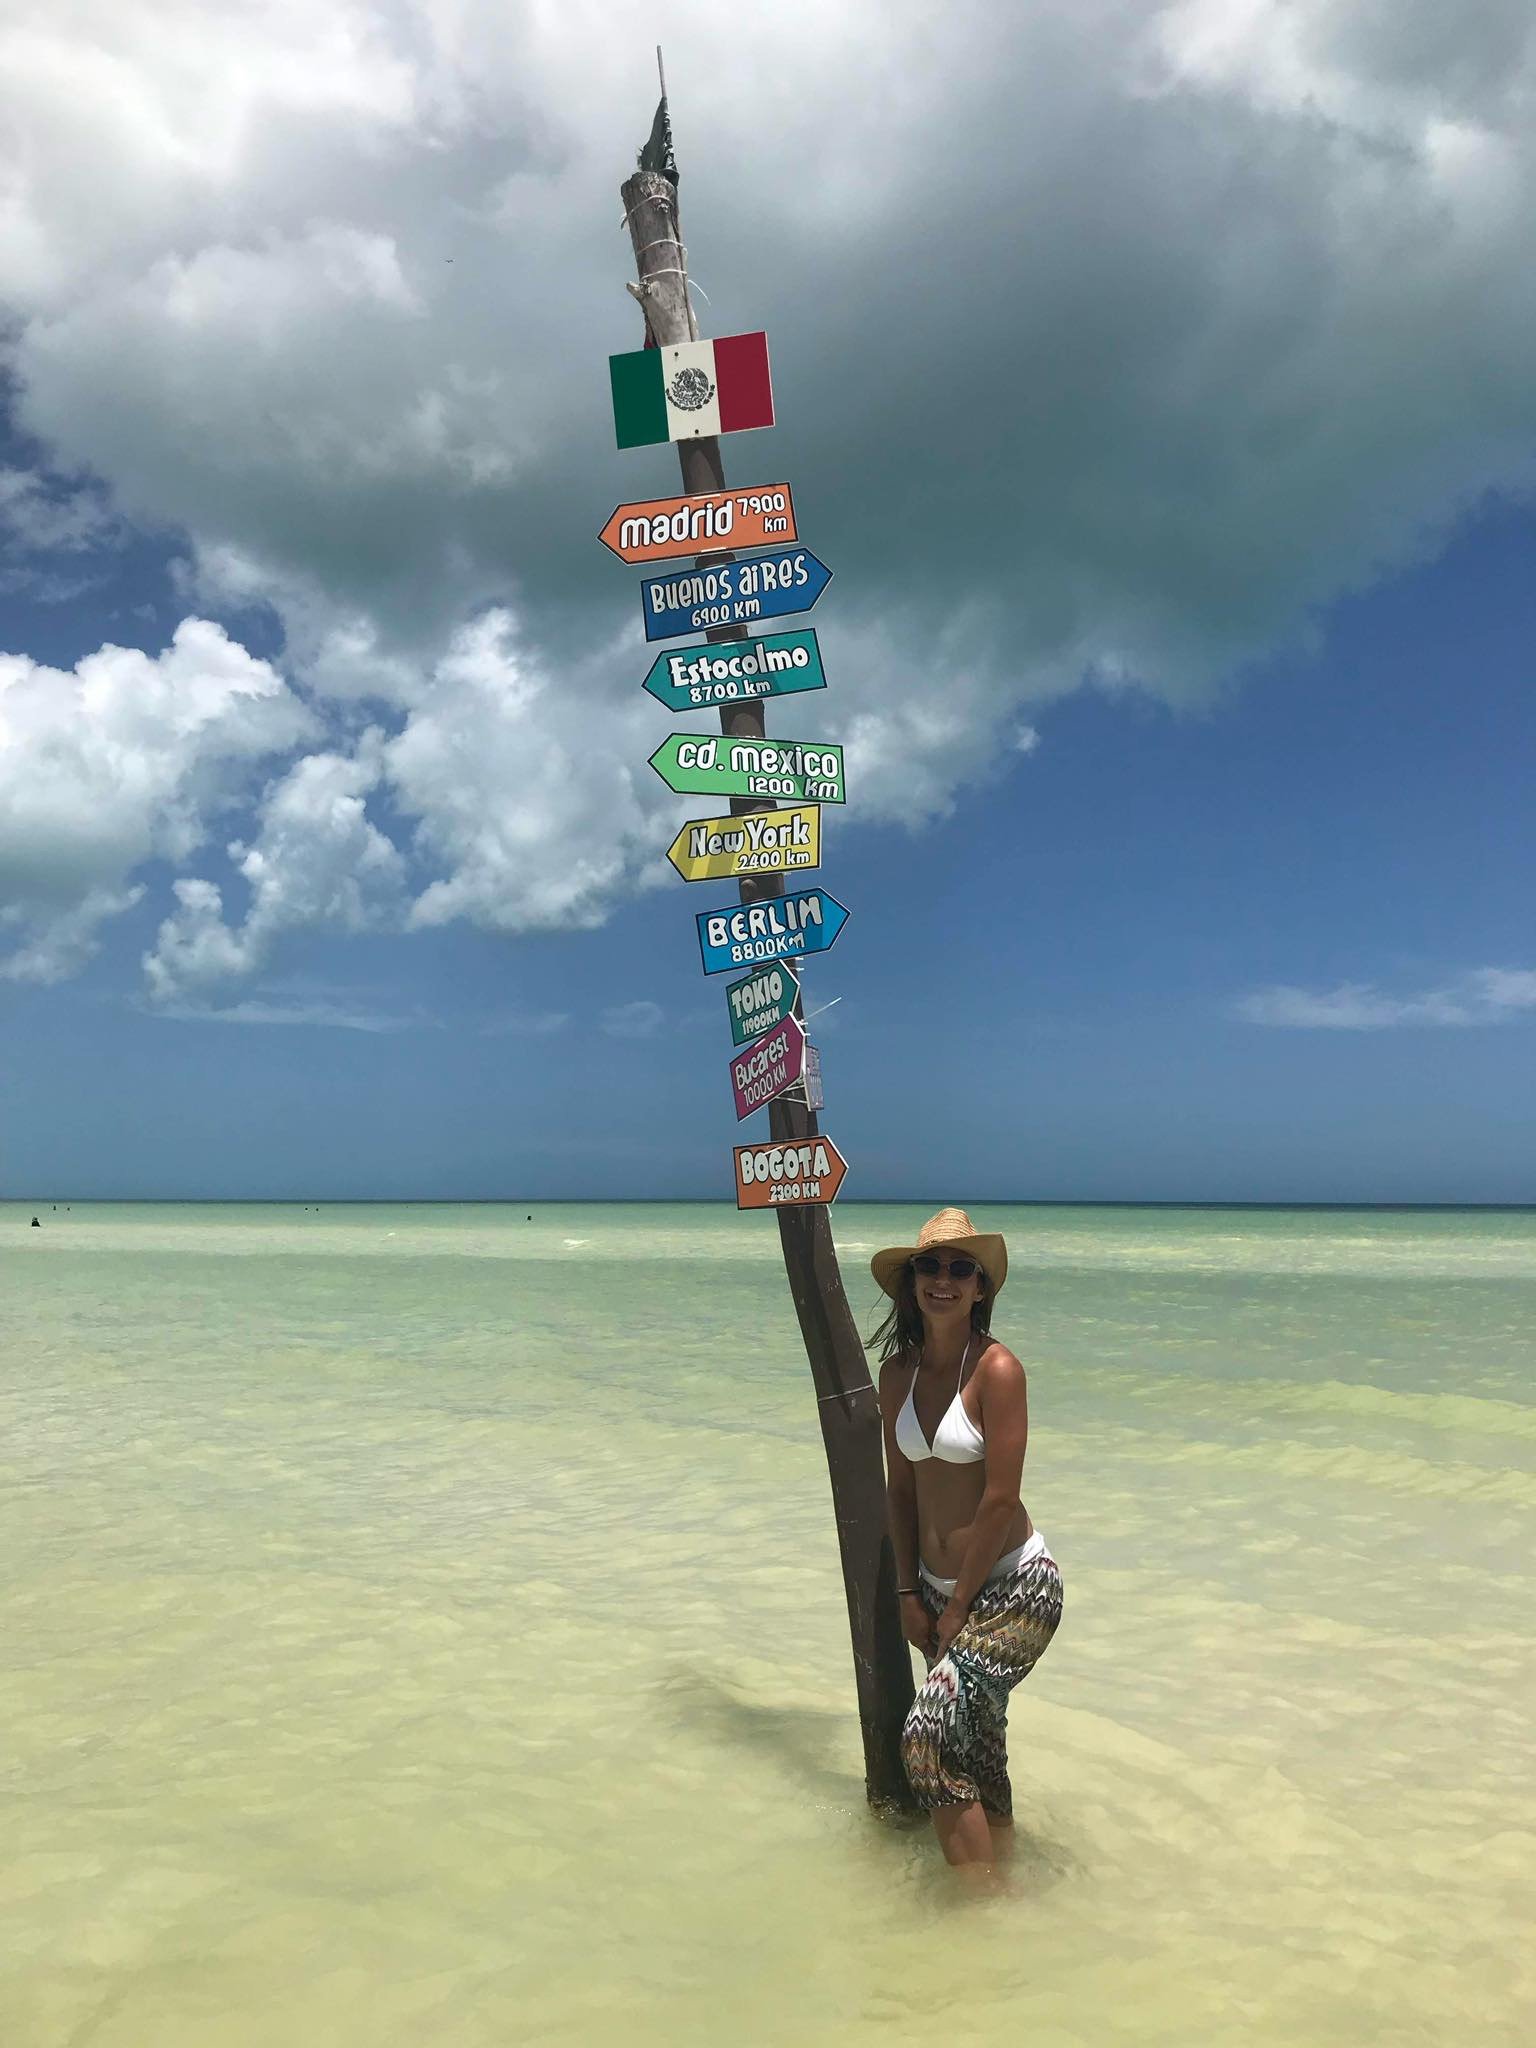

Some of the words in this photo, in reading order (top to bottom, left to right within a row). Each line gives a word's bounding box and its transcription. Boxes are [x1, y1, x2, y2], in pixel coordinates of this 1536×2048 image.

[620, 500, 734, 549] madrid
[736, 492, 785, 516] 7900
[691, 605, 730, 627] 6900
[668, 642, 809, 687] Estocolmo
[689, 681, 738, 703] 8700
[744, 679, 771, 695] km
[730, 746, 838, 778] mexico
[748, 776, 795, 795] 1200
[804, 778, 839, 798] km
[688, 826, 745, 858] New
[745, 814, 810, 850] York
[738, 852, 781, 870] 2400
[786, 849, 810, 865] km
[707, 896, 823, 947] BERLIN
[731, 971, 783, 1019] TOKIO
[735, 1031, 789, 1090] Bucarest
[743, 1073, 773, 1107] 10000
[773, 1062, 787, 1084] KM
[740, 1145, 831, 1184] BOGOTA
[802, 1181, 820, 1198] KM
